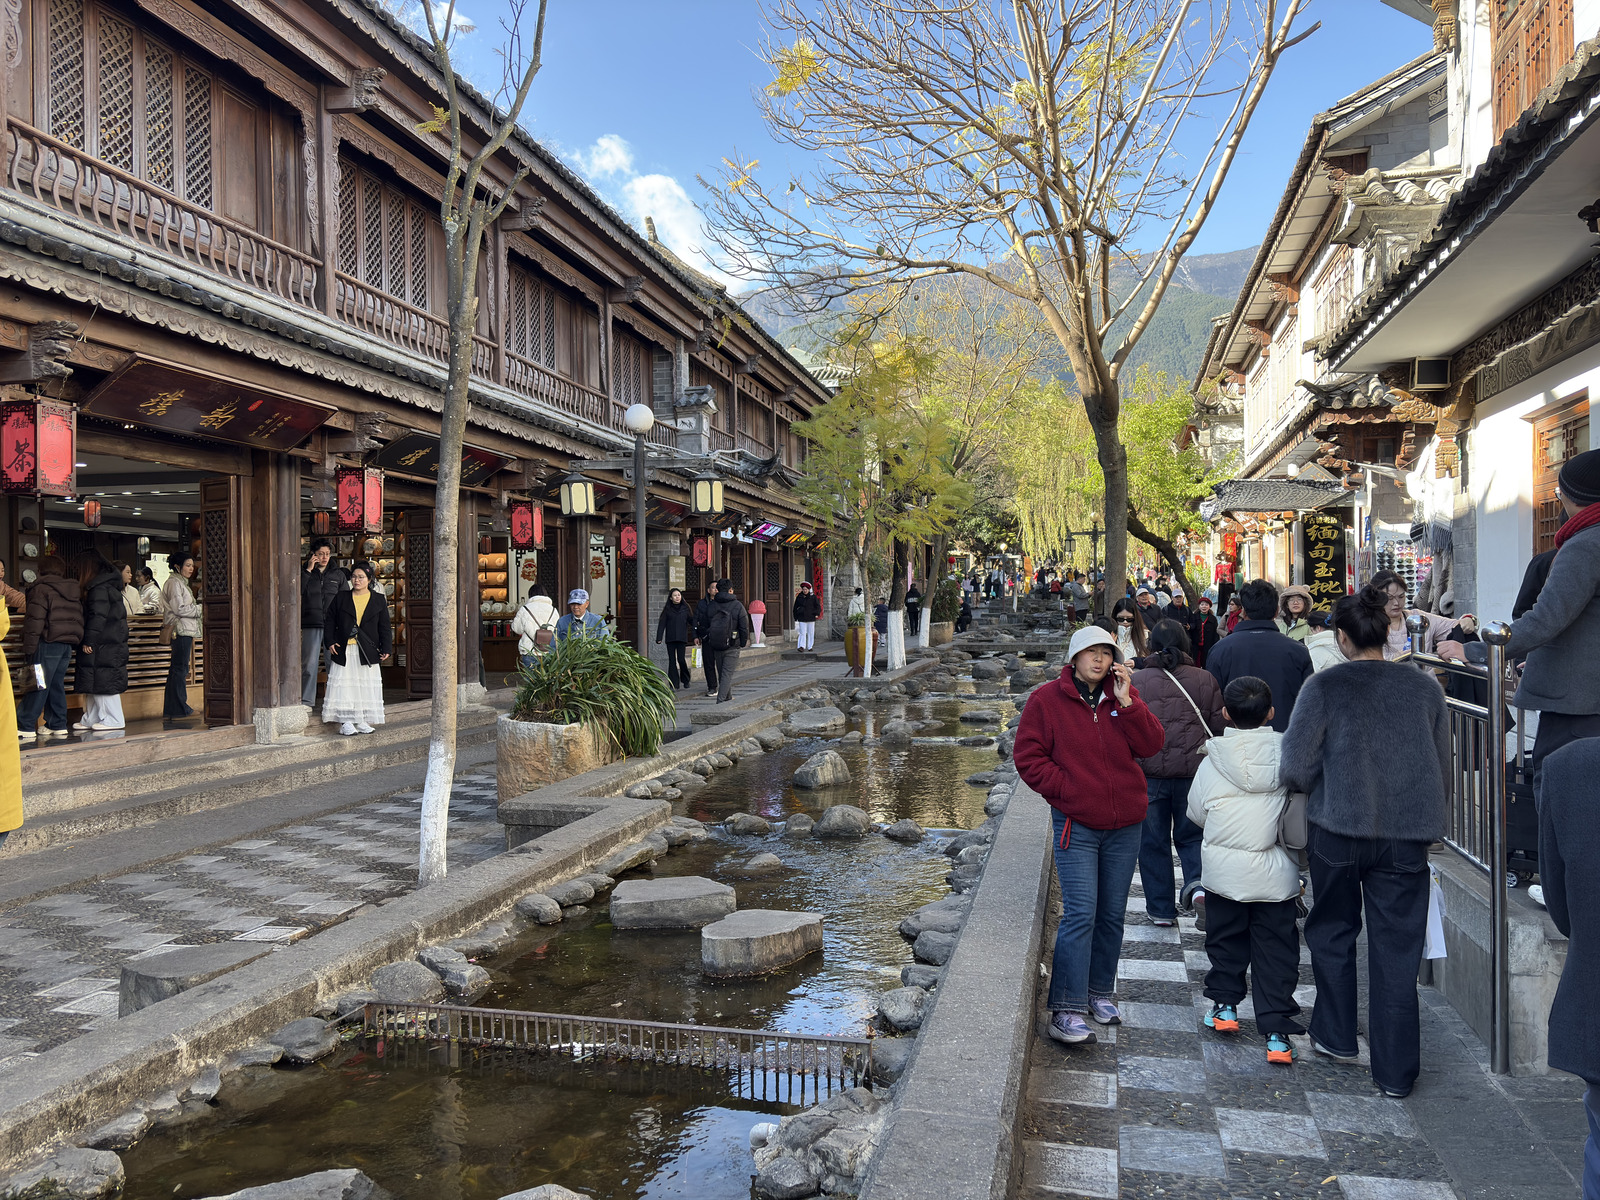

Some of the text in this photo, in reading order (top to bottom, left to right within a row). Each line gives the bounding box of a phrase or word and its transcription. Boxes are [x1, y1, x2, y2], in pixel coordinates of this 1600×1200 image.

[6, 437, 35, 472] 茶
[341, 492, 363, 516] 茶
[514, 520, 532, 538] 茶
[623, 537, 637, 552] 茶
